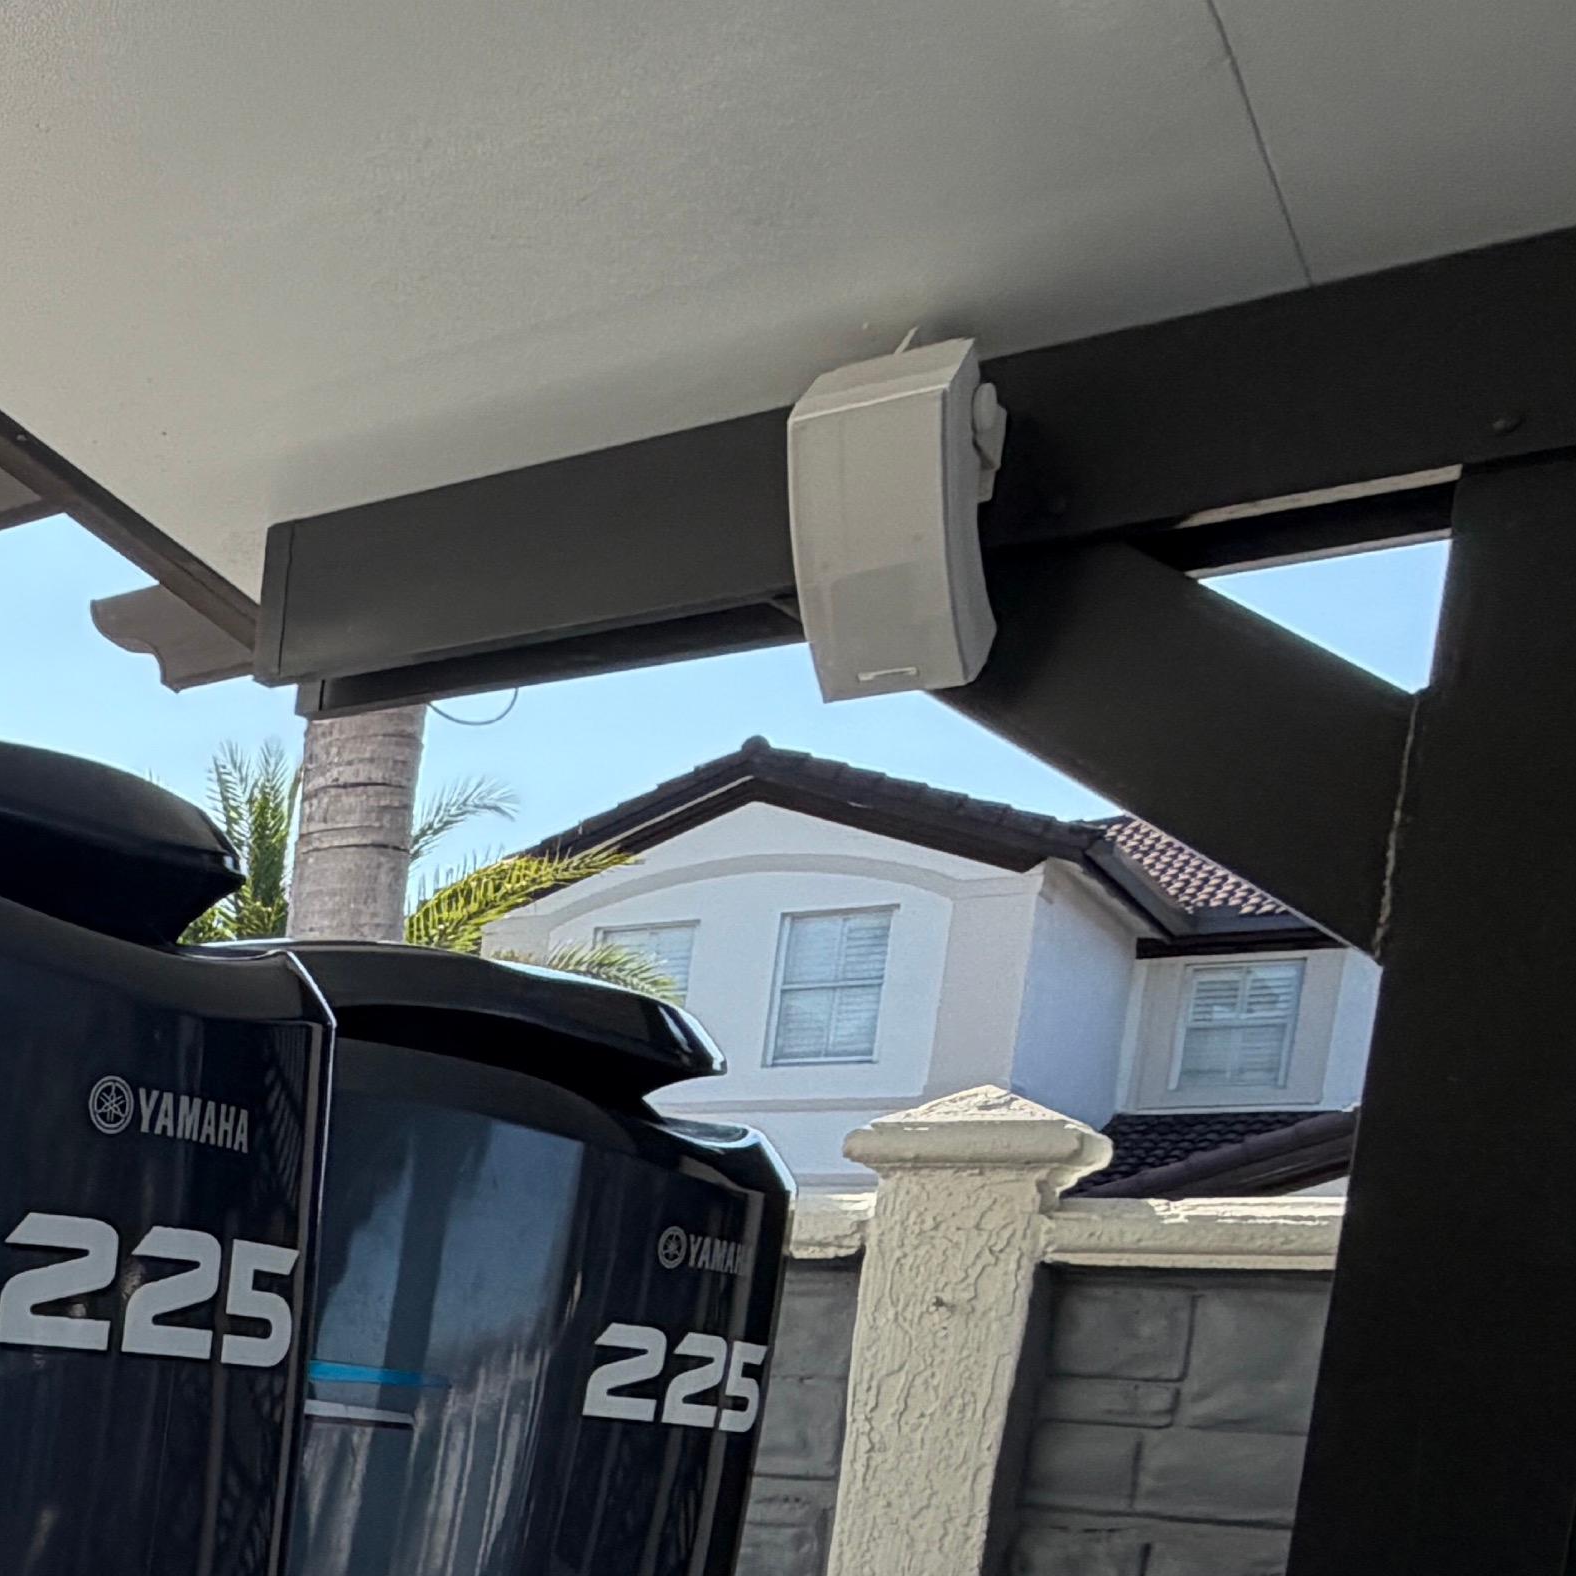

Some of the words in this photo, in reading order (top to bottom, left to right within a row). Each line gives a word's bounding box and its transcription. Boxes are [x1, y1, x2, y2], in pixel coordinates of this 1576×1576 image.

[139, 1087, 249, 1154] YAMAHA
[688, 1233, 751, 1277] YAMAH
[582, 1322, 768, 1433] 225
